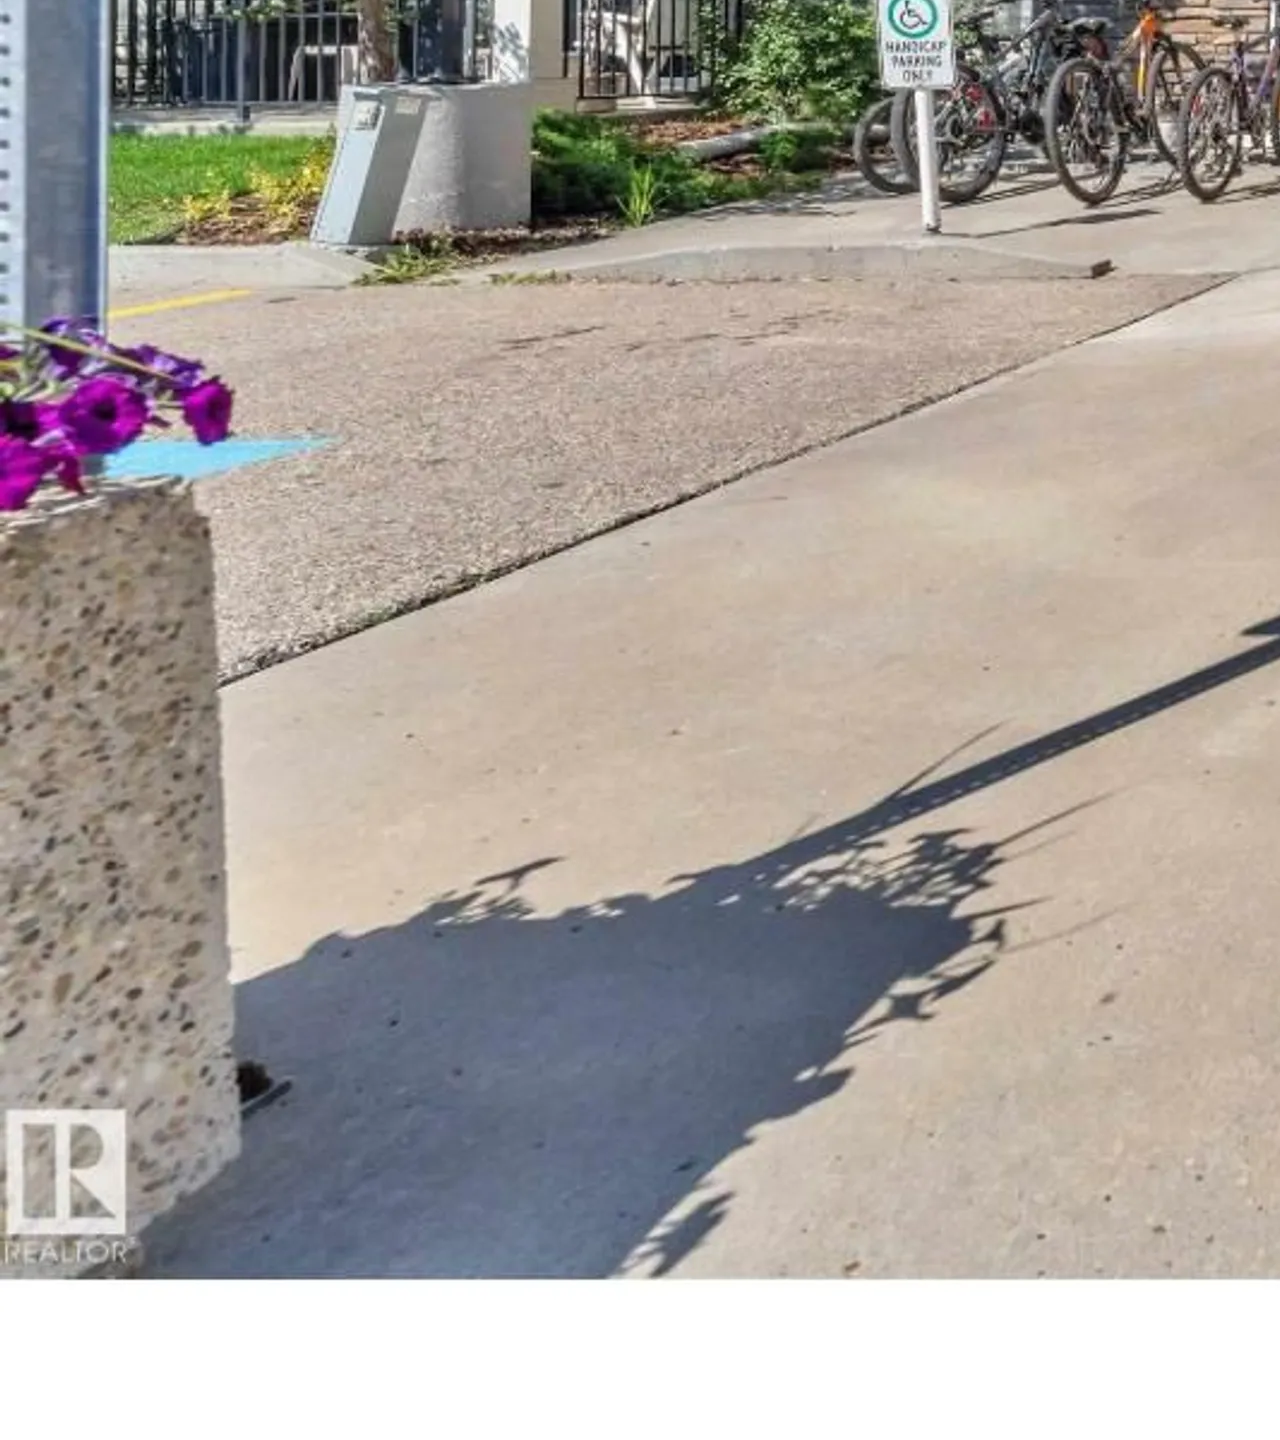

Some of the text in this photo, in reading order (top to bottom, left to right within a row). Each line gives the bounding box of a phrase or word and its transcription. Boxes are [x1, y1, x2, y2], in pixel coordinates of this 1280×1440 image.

[885, 40, 946, 54] HANDICAP
[891, 55, 942, 68] PARKING
[902, 69, 933, 83] ONLY
